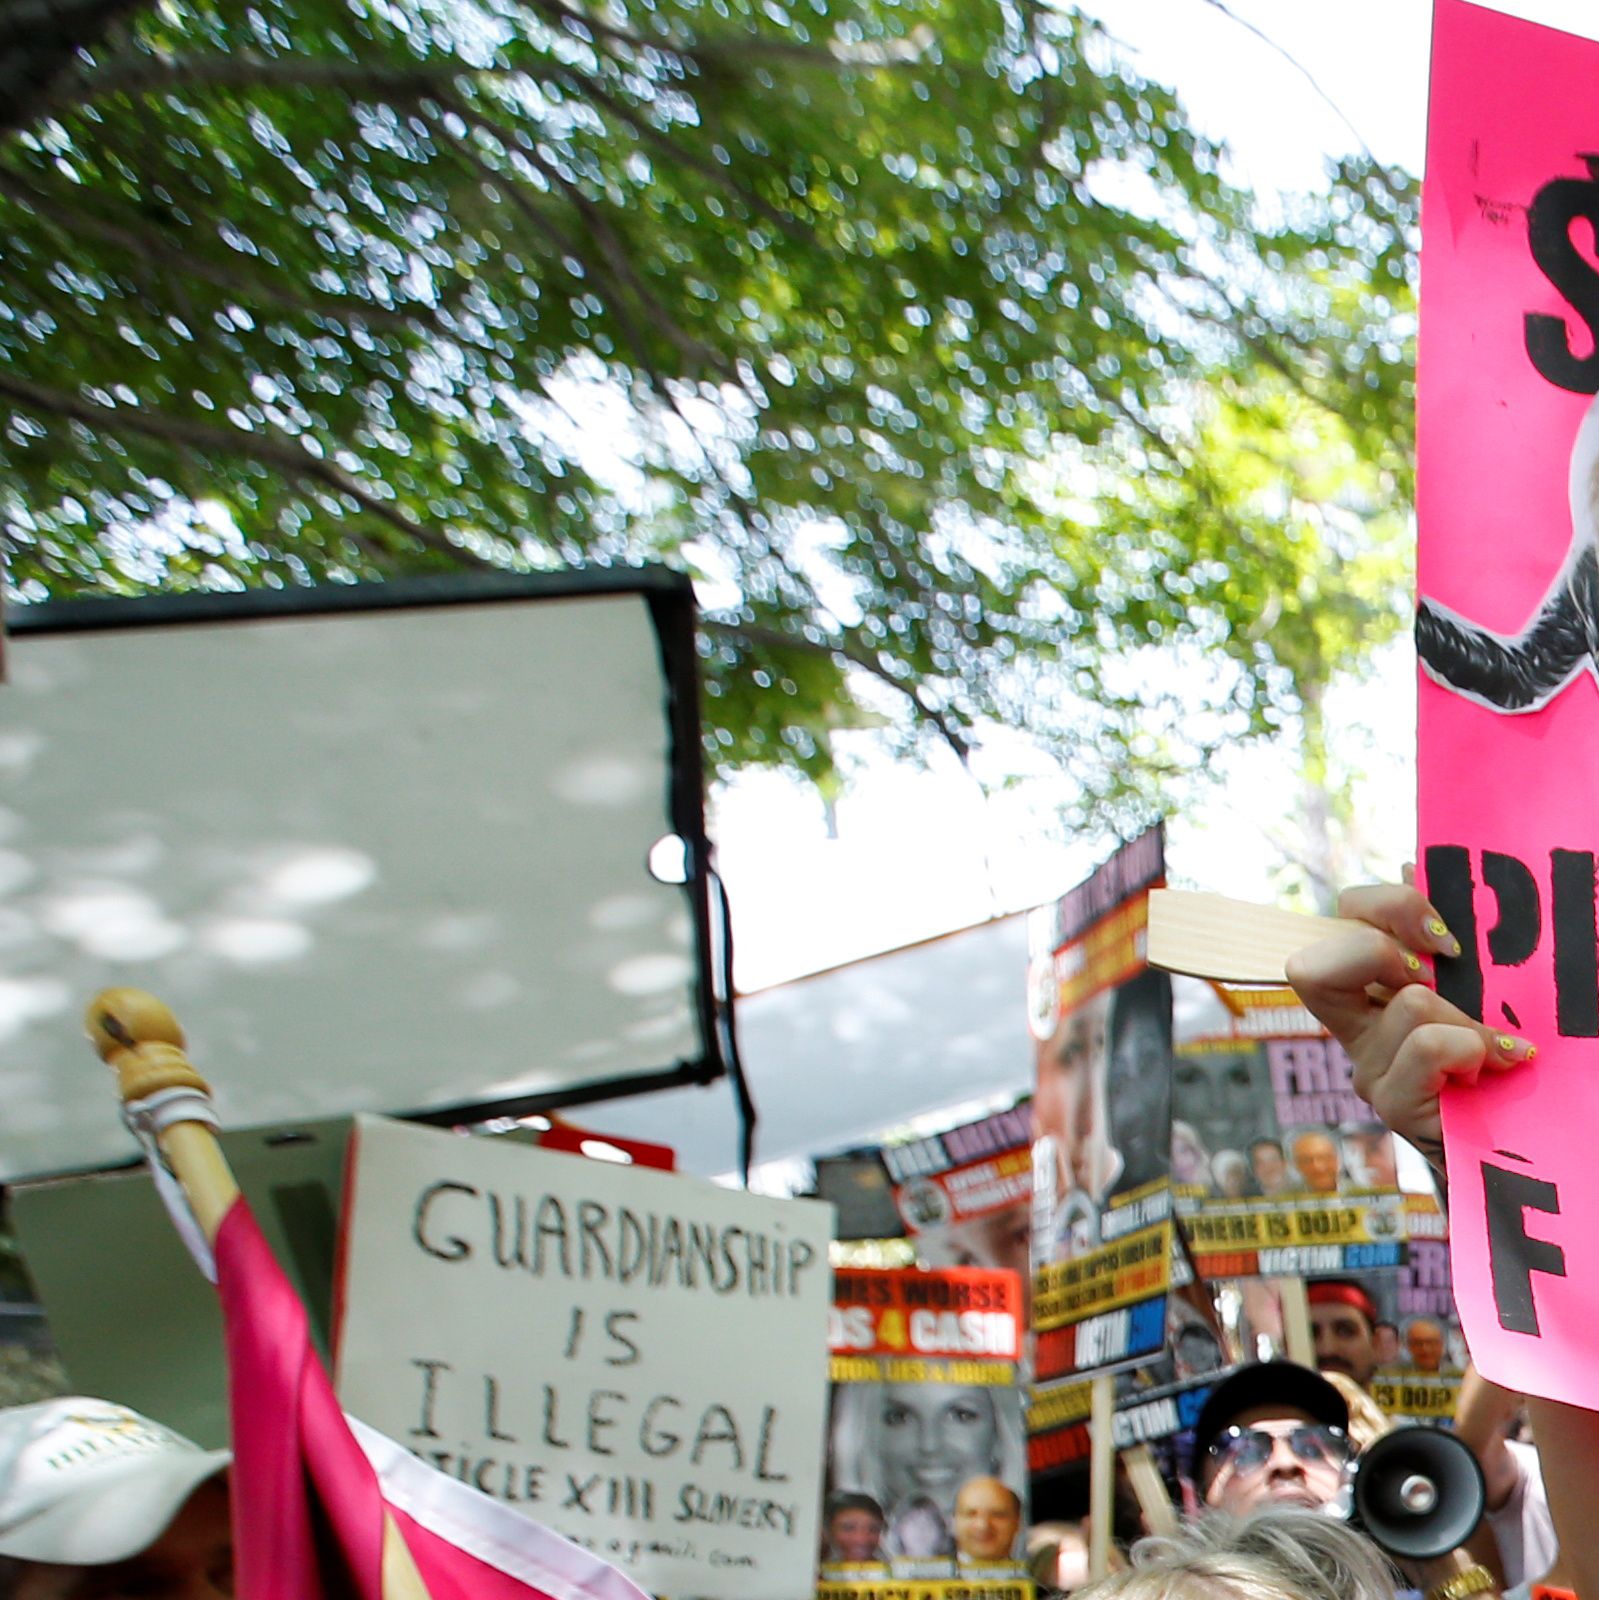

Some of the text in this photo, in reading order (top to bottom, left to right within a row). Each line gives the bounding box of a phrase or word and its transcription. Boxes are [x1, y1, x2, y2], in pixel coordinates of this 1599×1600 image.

[411, 1179, 815, 1297] GUARDIANSHIP
[564, 1306, 642, 1366] IS
[876, 1308, 906, 1349] 4
[909, 1309, 1017, 1355] CASH
[408, 1358, 789, 1484] ILLEGAL
